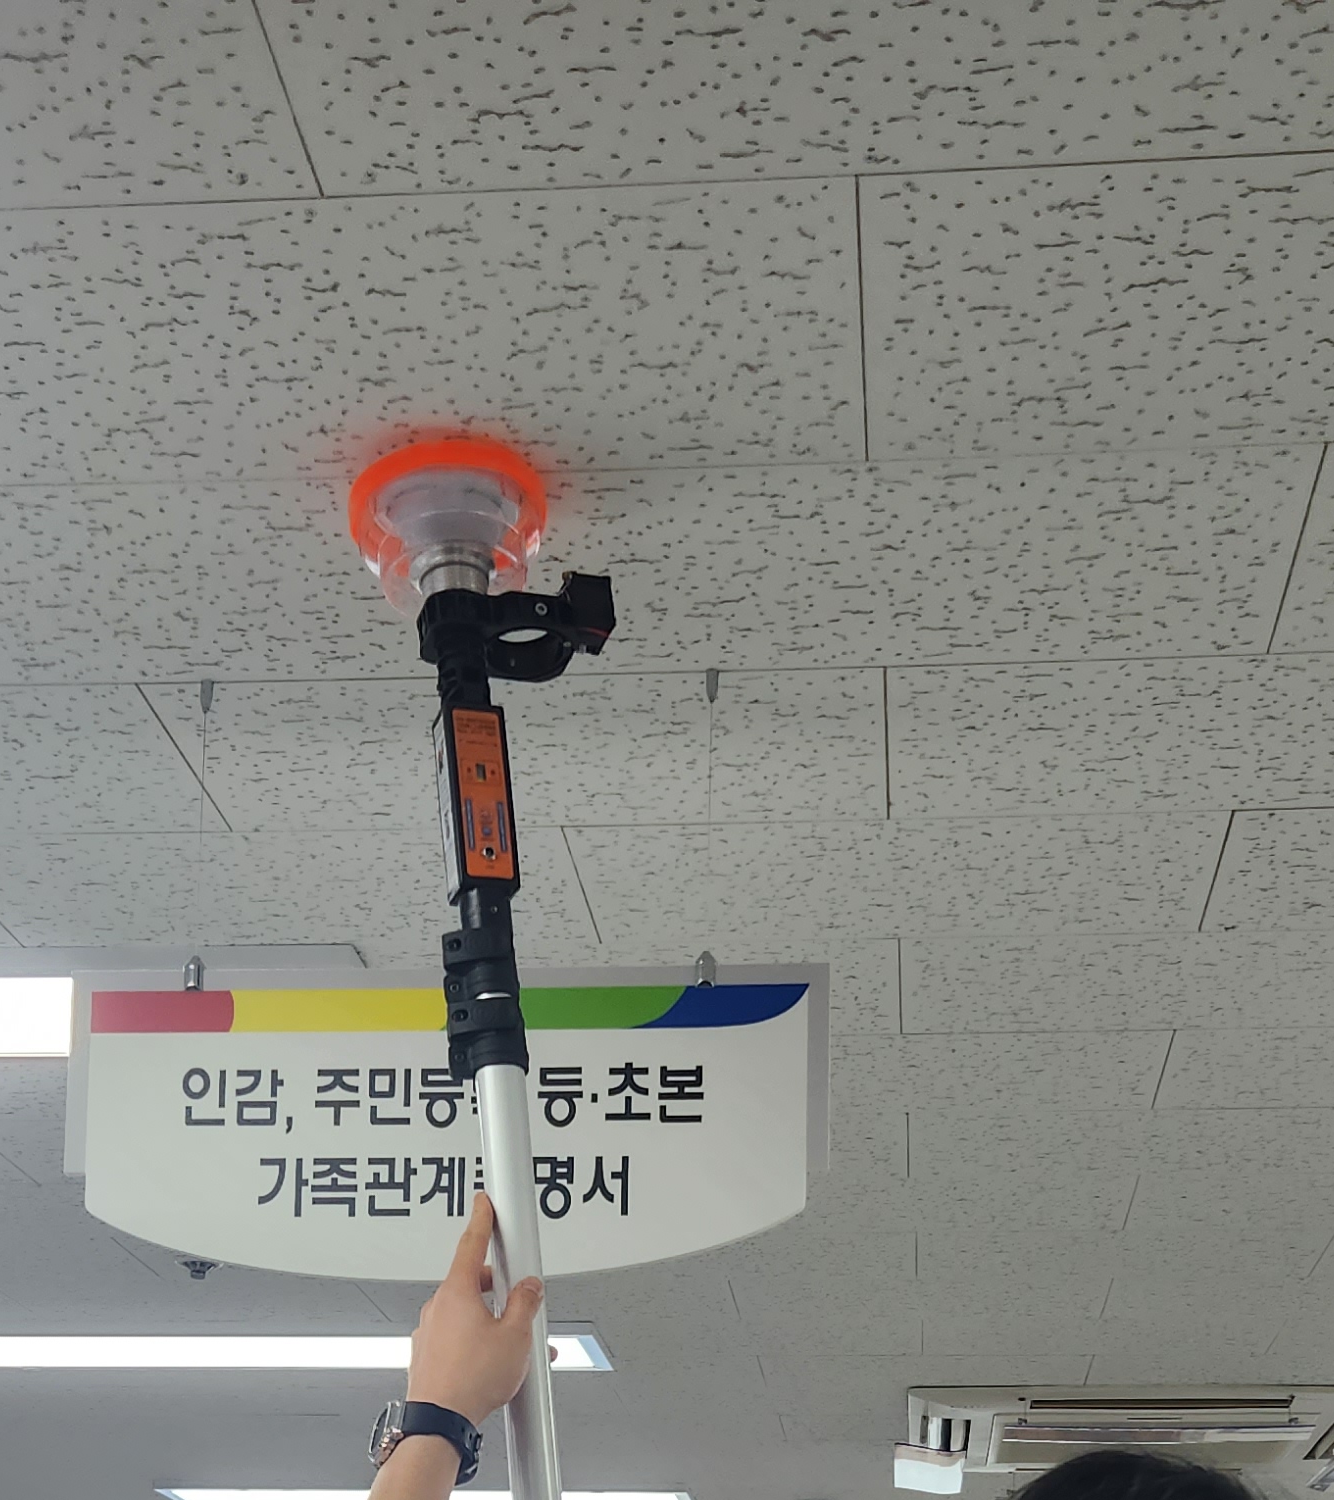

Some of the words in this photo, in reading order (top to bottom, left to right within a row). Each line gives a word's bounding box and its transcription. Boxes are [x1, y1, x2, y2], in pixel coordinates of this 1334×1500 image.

[181, 1067, 294, 1134] 인감,
[314, 1067, 478, 1128] 주민등
[258, 1155, 630, 1219] 가족관계명서
